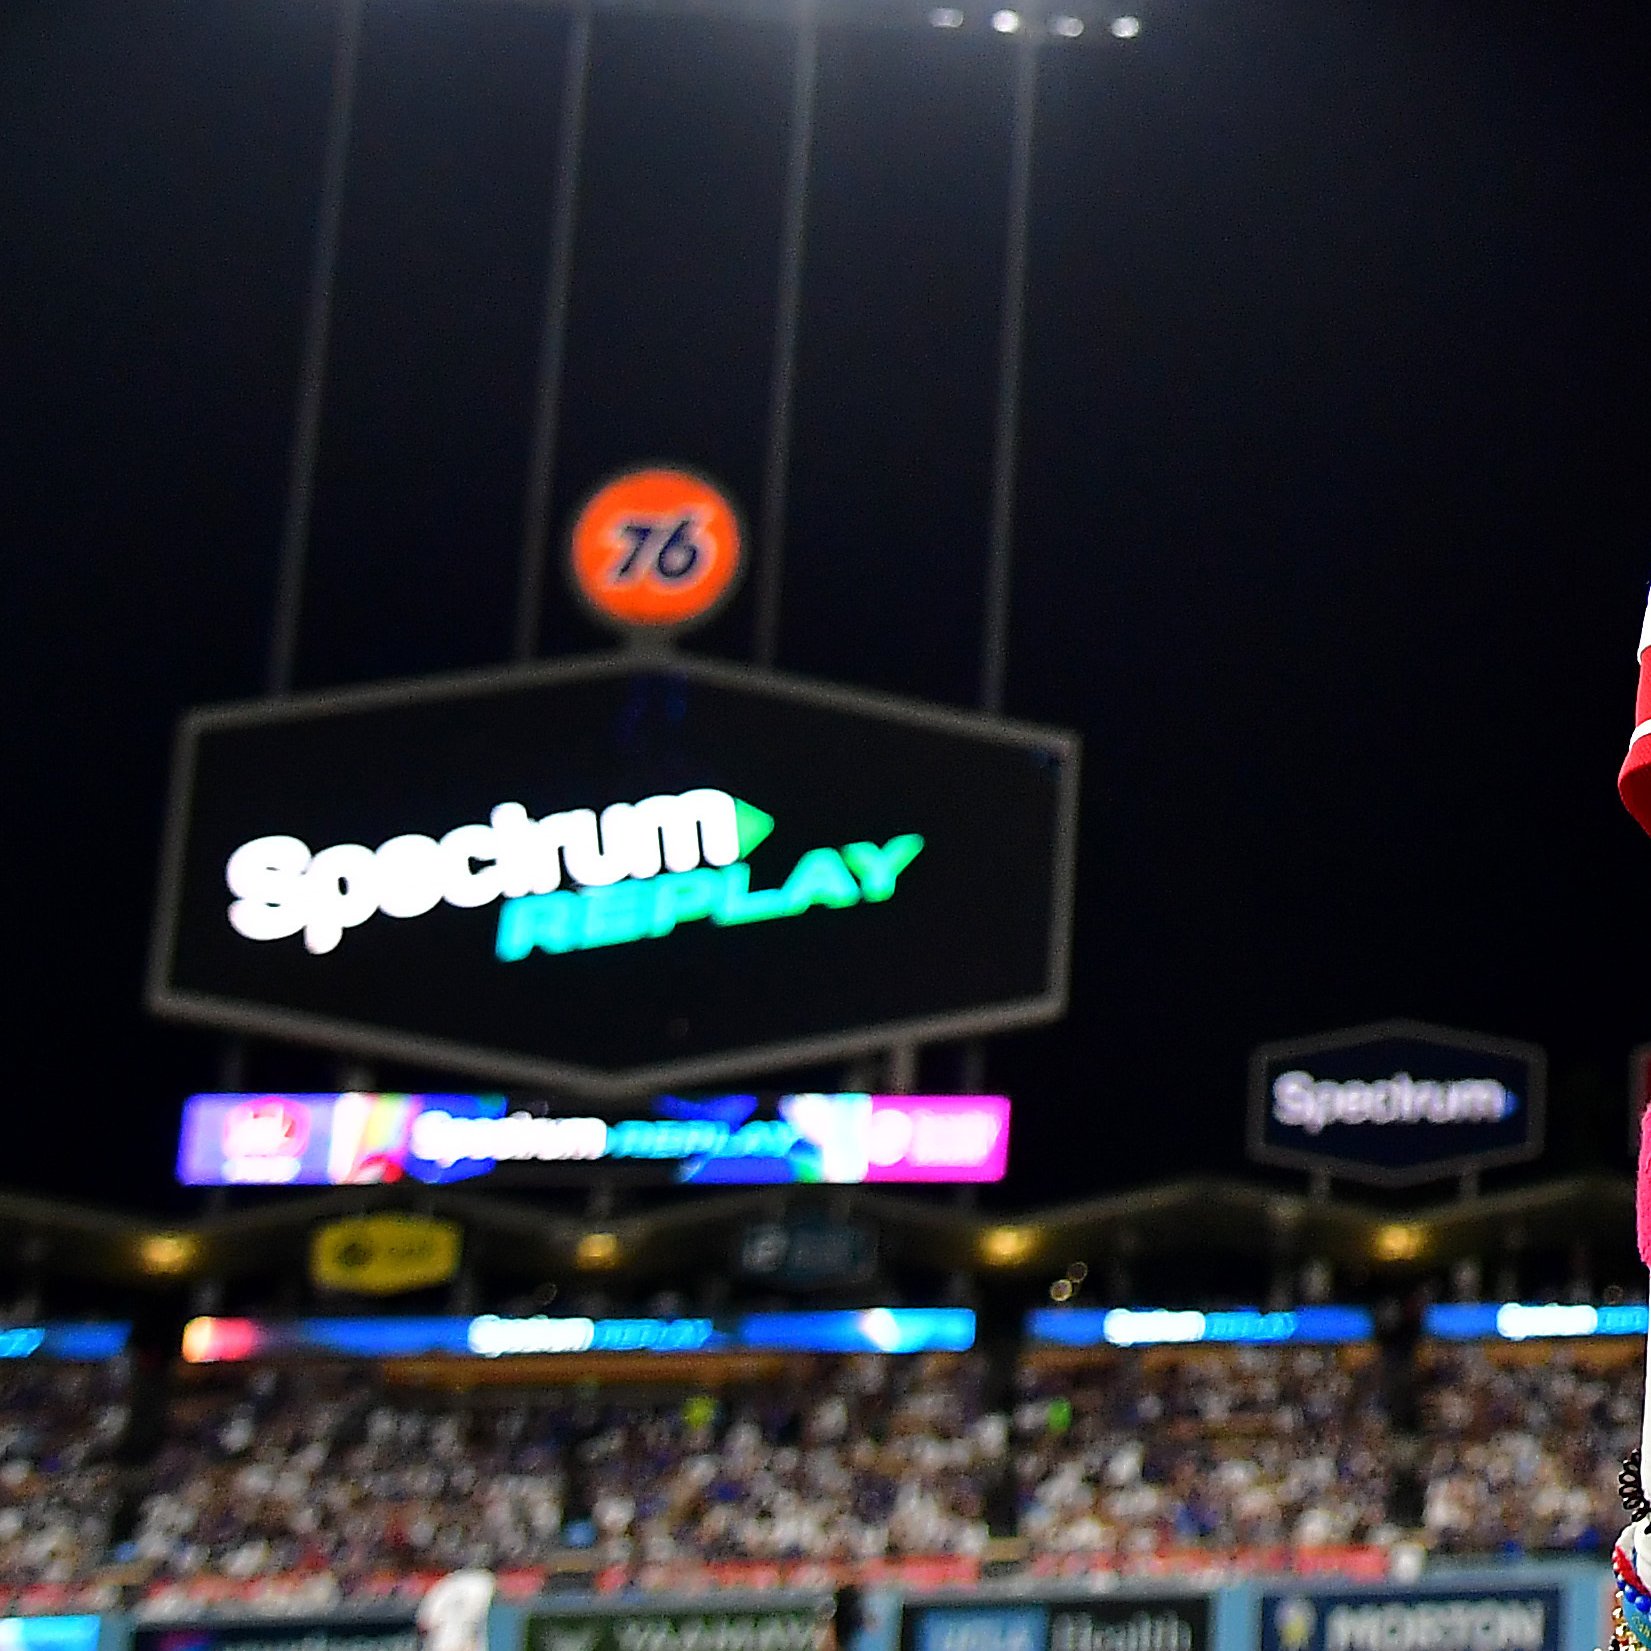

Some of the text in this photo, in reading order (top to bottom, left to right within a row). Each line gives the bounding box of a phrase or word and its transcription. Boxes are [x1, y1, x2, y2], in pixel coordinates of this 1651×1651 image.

[608, 511, 708, 584] 76
[227, 788, 741, 953] Spectrum
[495, 834, 924, 962] REPLAY
[1273, 1070, 1507, 1133] Spectrum
